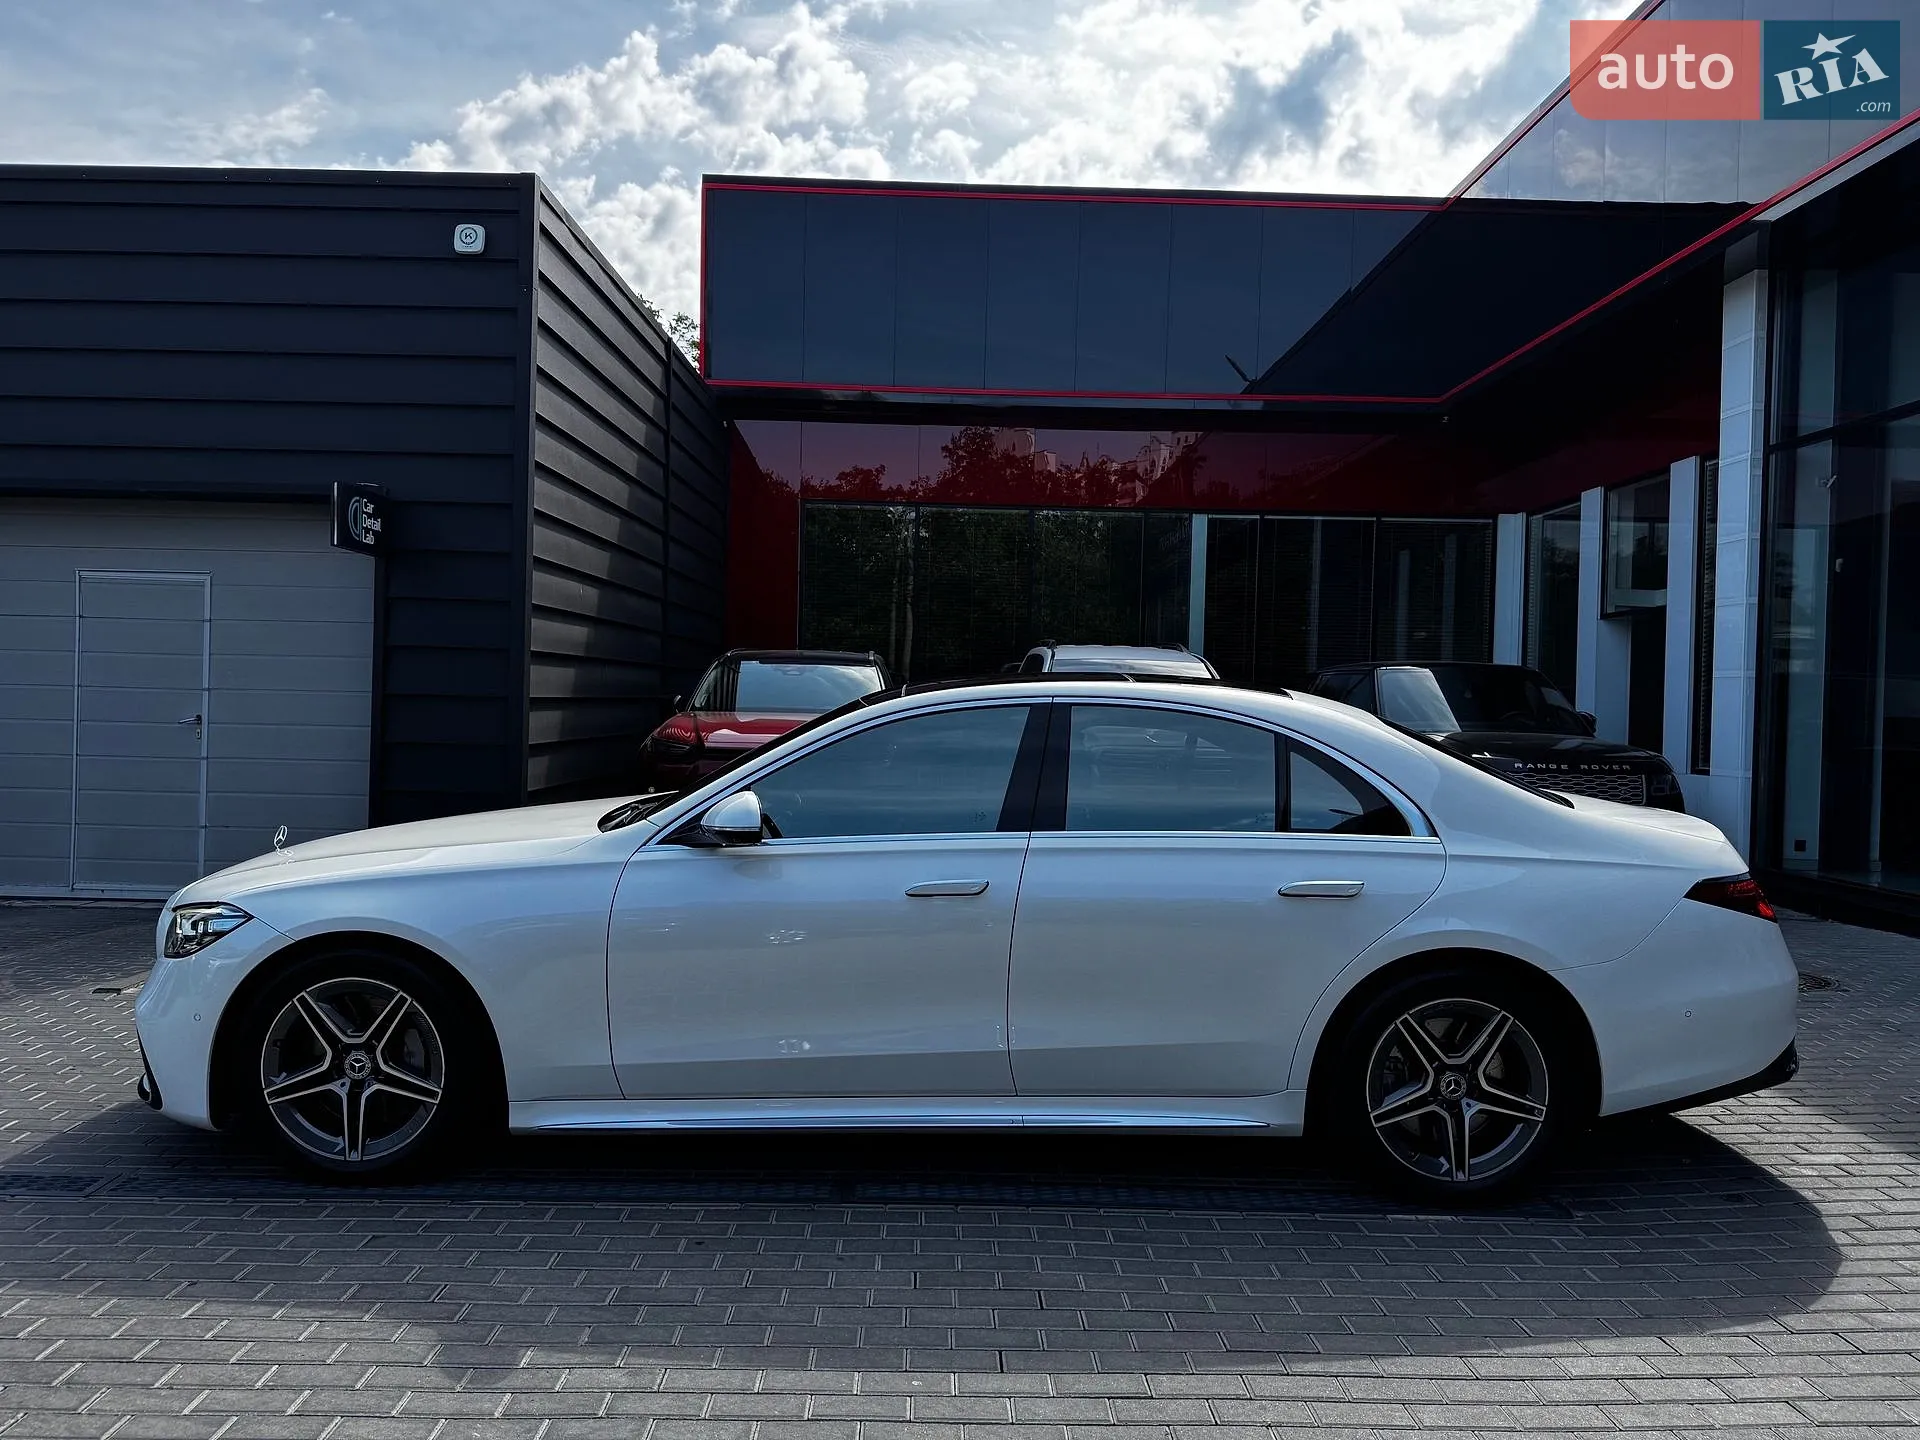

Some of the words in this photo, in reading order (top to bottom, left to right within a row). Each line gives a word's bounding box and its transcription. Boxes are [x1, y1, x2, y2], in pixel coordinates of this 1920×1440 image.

[362, 498, 375, 514] Car
[362, 513, 382, 532] Detail
[362, 529, 375, 545] Lab
[1514, 762, 1569, 770] RANGE
[1580, 763, 1632, 771] ROVER
